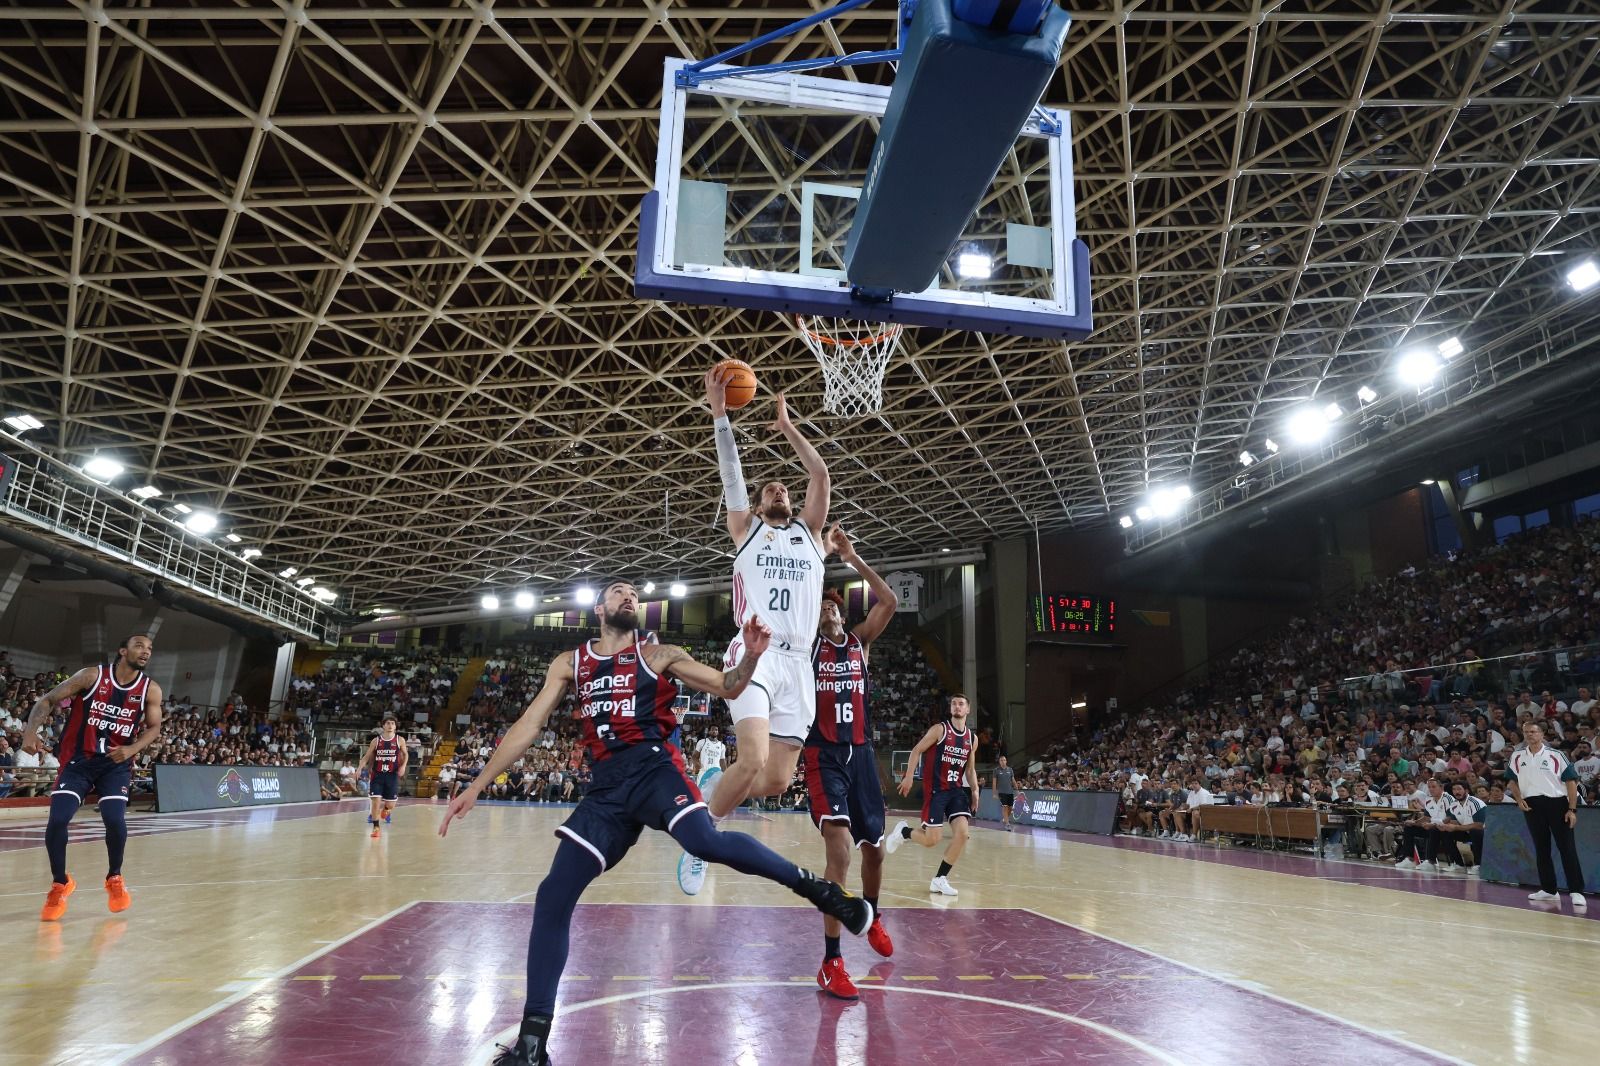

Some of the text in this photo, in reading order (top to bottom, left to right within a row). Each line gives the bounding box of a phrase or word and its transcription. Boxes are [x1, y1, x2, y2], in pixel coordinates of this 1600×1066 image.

[756, 553, 812, 571] Emirates
[763, 568, 805, 582] FLY BETTER
[768, 587, 791, 612] 20
[581, 695, 636, 718] ingroyal
[834, 702, 854, 724] 16
[99, 737, 107, 754] 1
[947, 769, 960, 782] 25
[251, 777, 280, 792] URBANO
[1033, 800, 1060, 815] URBANO
